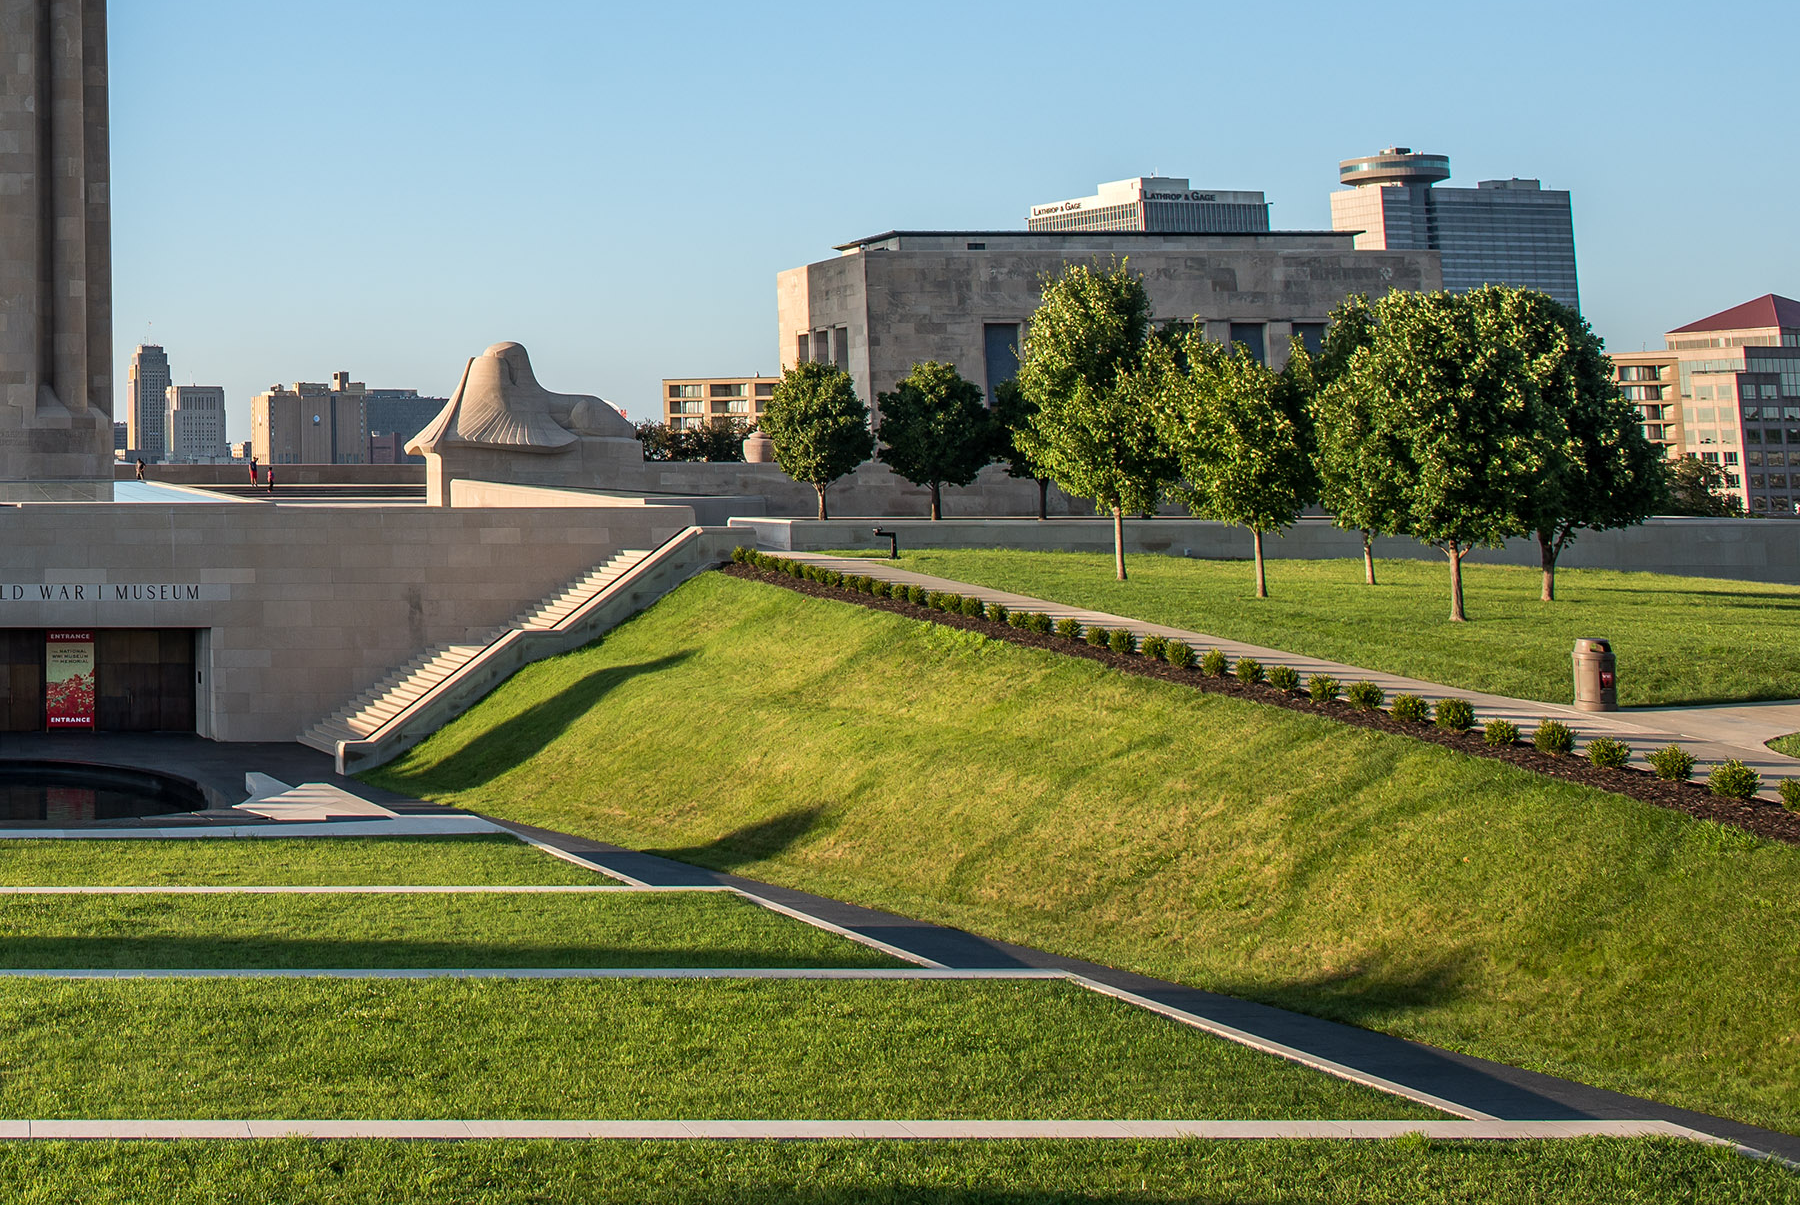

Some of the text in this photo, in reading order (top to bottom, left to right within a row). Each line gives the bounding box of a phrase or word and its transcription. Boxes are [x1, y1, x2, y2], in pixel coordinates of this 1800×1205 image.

[1191, 191, 1216, 201] GAGE
[39, 585, 85, 600] WAR
[98, 585, 102, 600] I
[115, 585, 200, 600] MUSEUM
